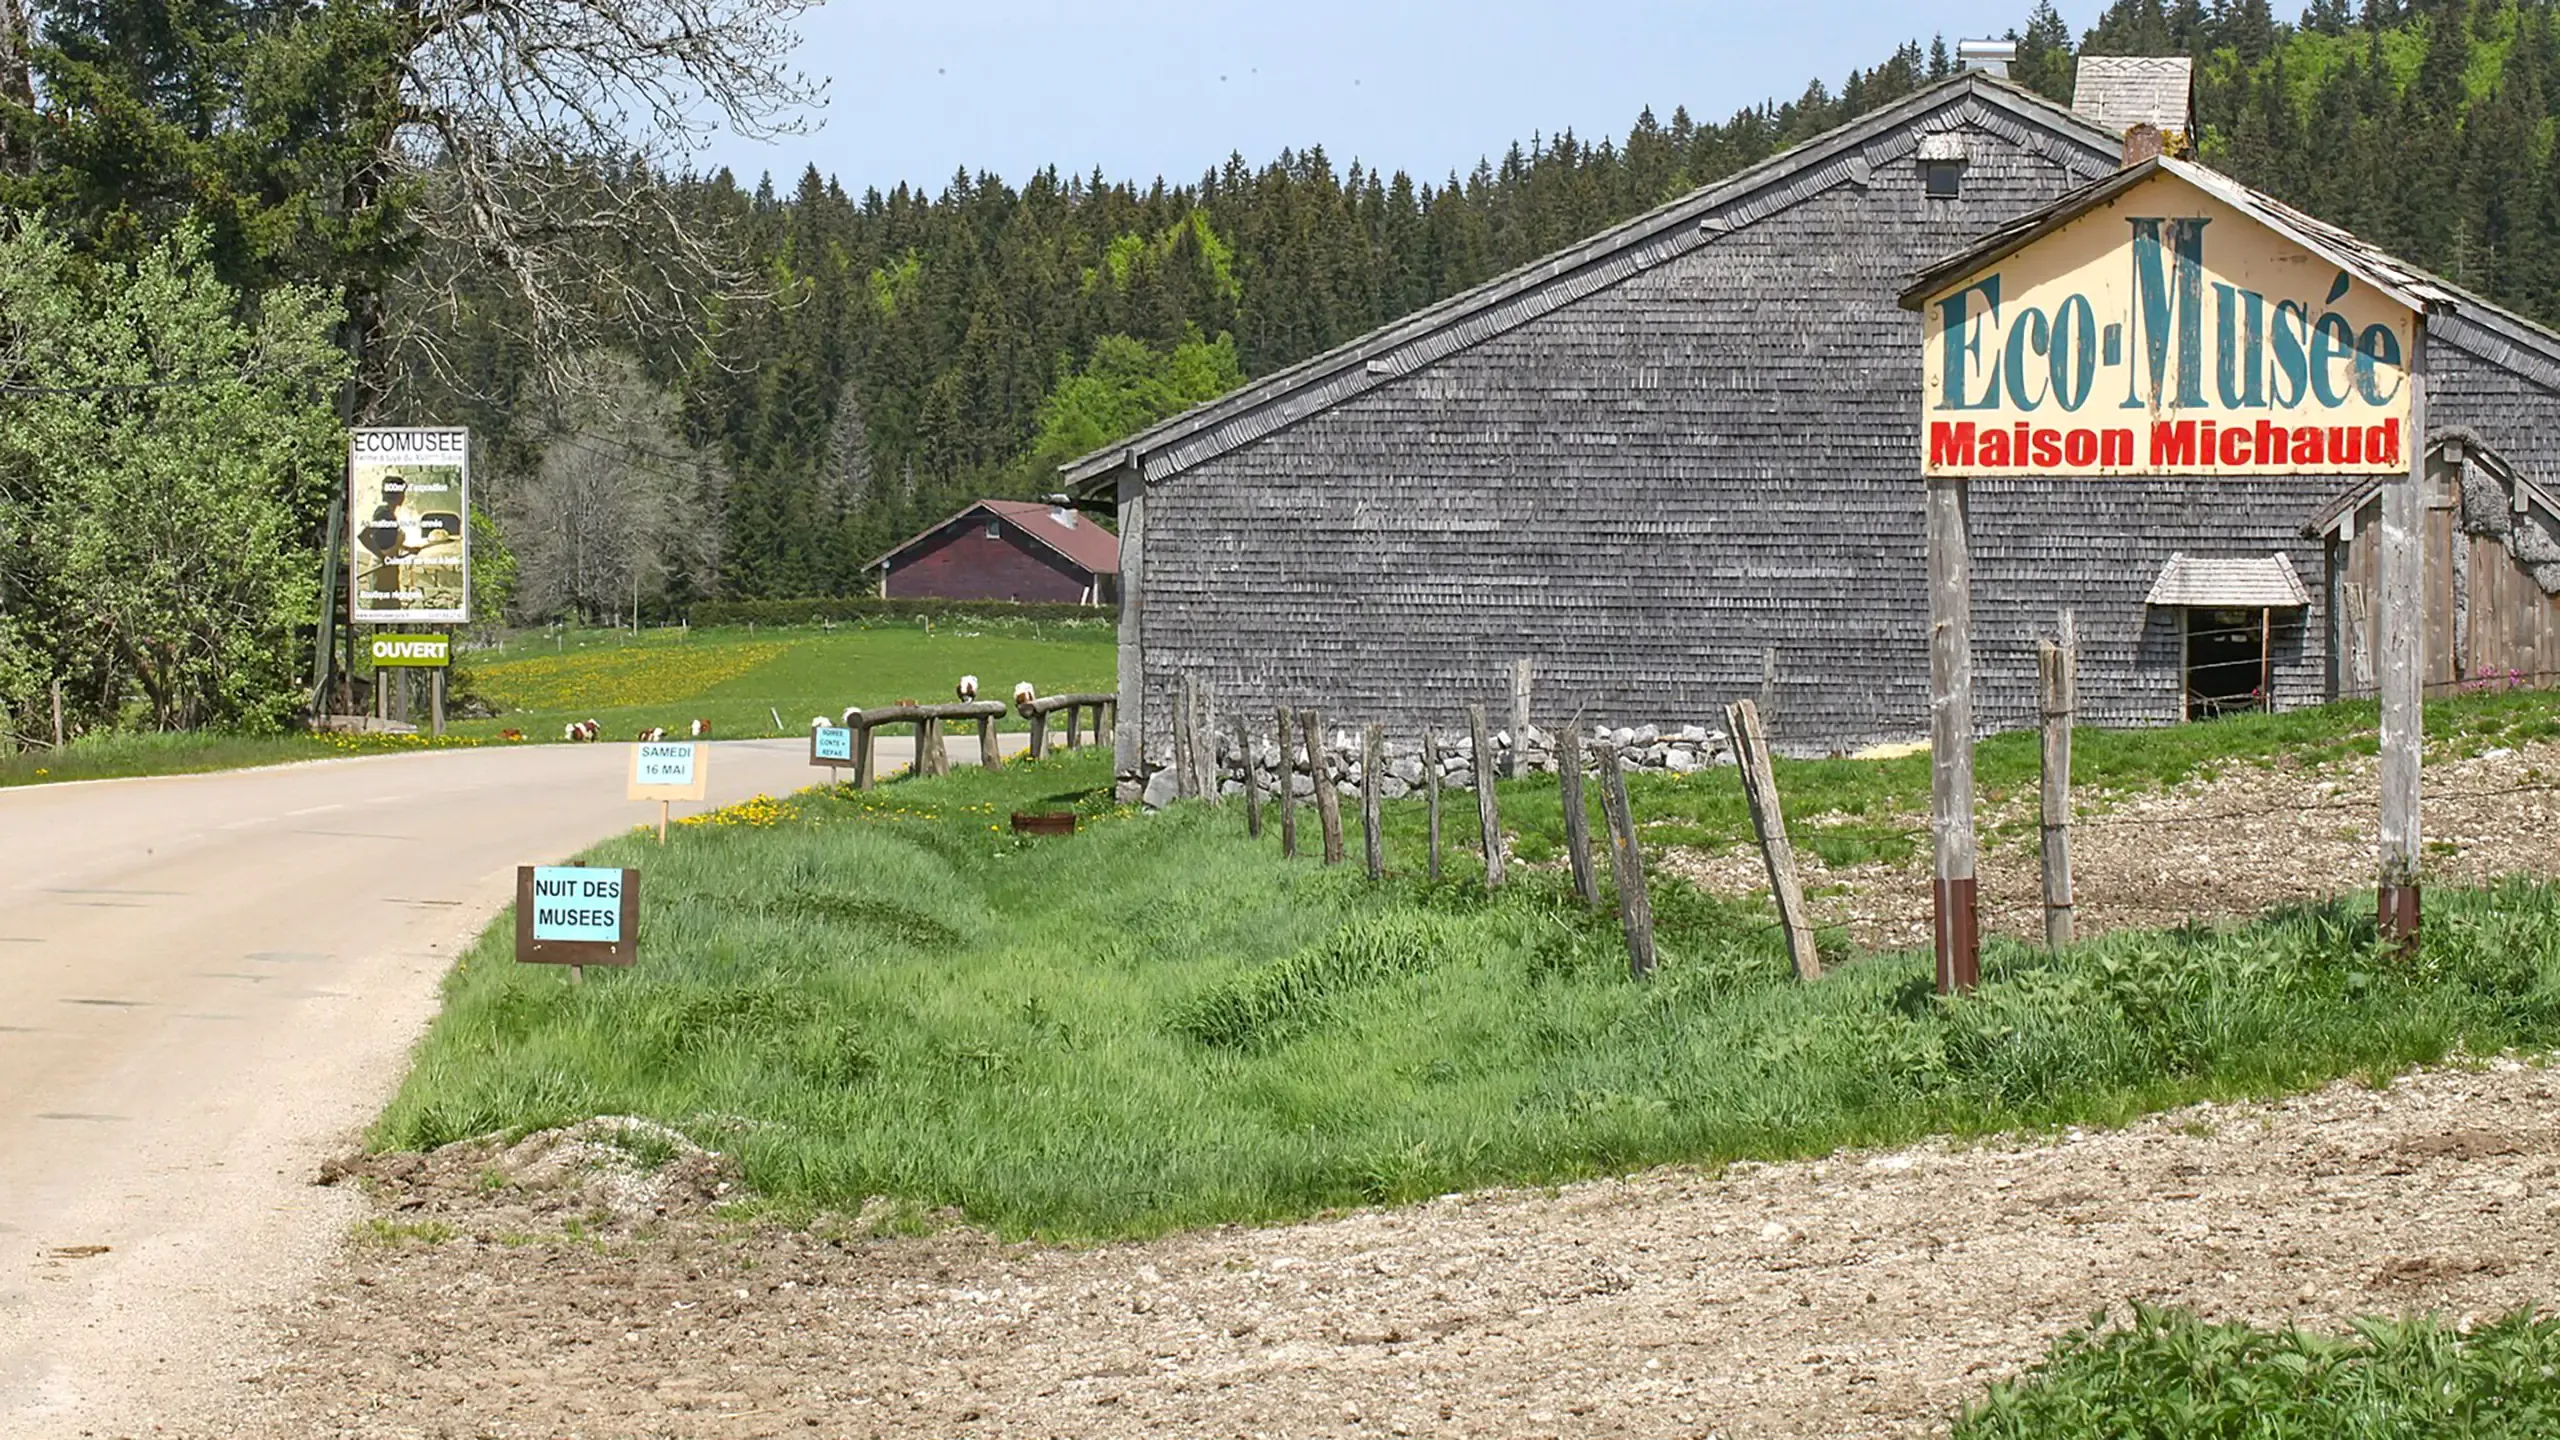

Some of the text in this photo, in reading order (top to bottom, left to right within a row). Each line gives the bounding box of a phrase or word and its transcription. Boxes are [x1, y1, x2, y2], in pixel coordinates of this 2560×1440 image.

[1933, 216, 2402, 412] Eco-Musée
[355, 431, 463, 452] ECOMUSEE
[1930, 417, 2399, 467] Maison Michaud
[373, 641, 449, 659] OUVERT
[642, 746, 691, 758] SAMEDI
[646, 764, 686, 775] 16 MAI
[536, 880, 620, 899] NUIT DES
[539, 908, 615, 927] MUSEES
